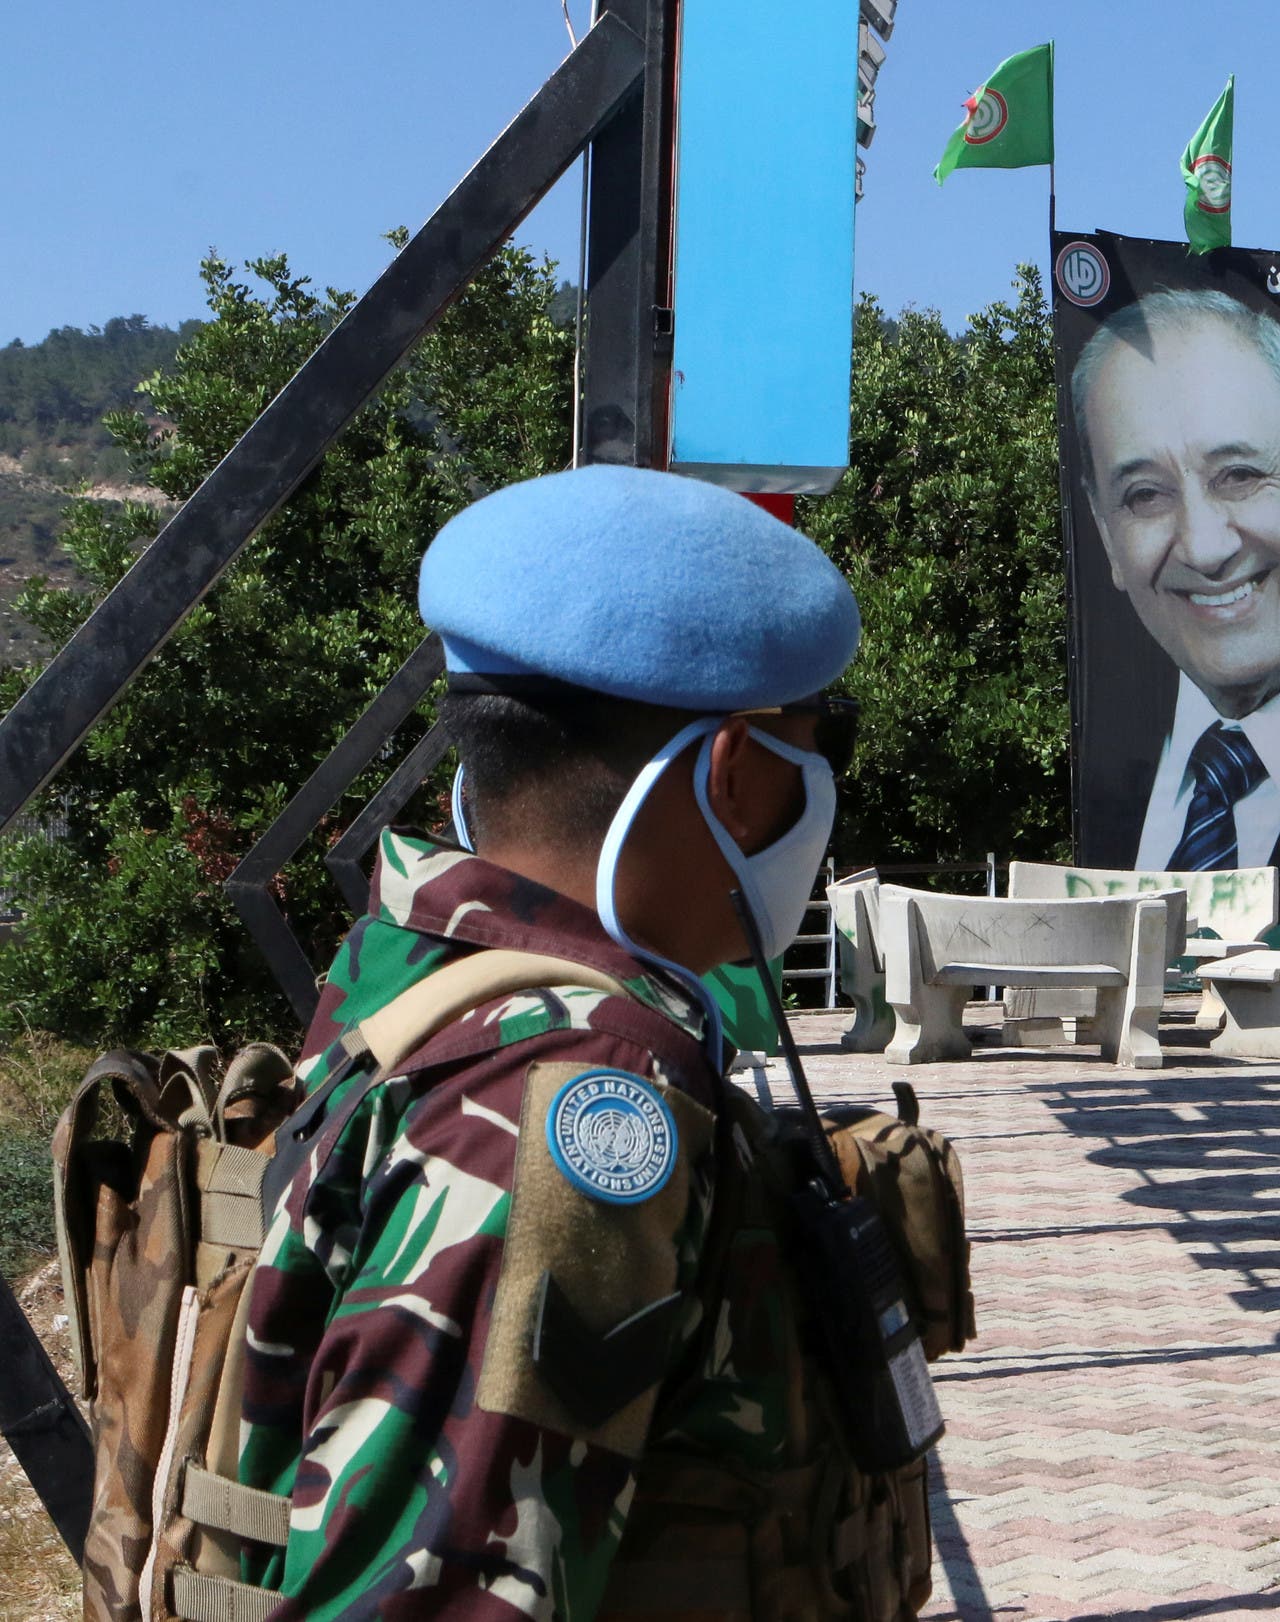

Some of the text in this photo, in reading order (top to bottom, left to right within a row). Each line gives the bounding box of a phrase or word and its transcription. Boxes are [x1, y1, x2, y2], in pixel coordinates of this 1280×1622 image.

[561, 1081, 665, 1137] UNITED NATIONS
[565, 1142, 666, 1191] NATIONS UNIES
